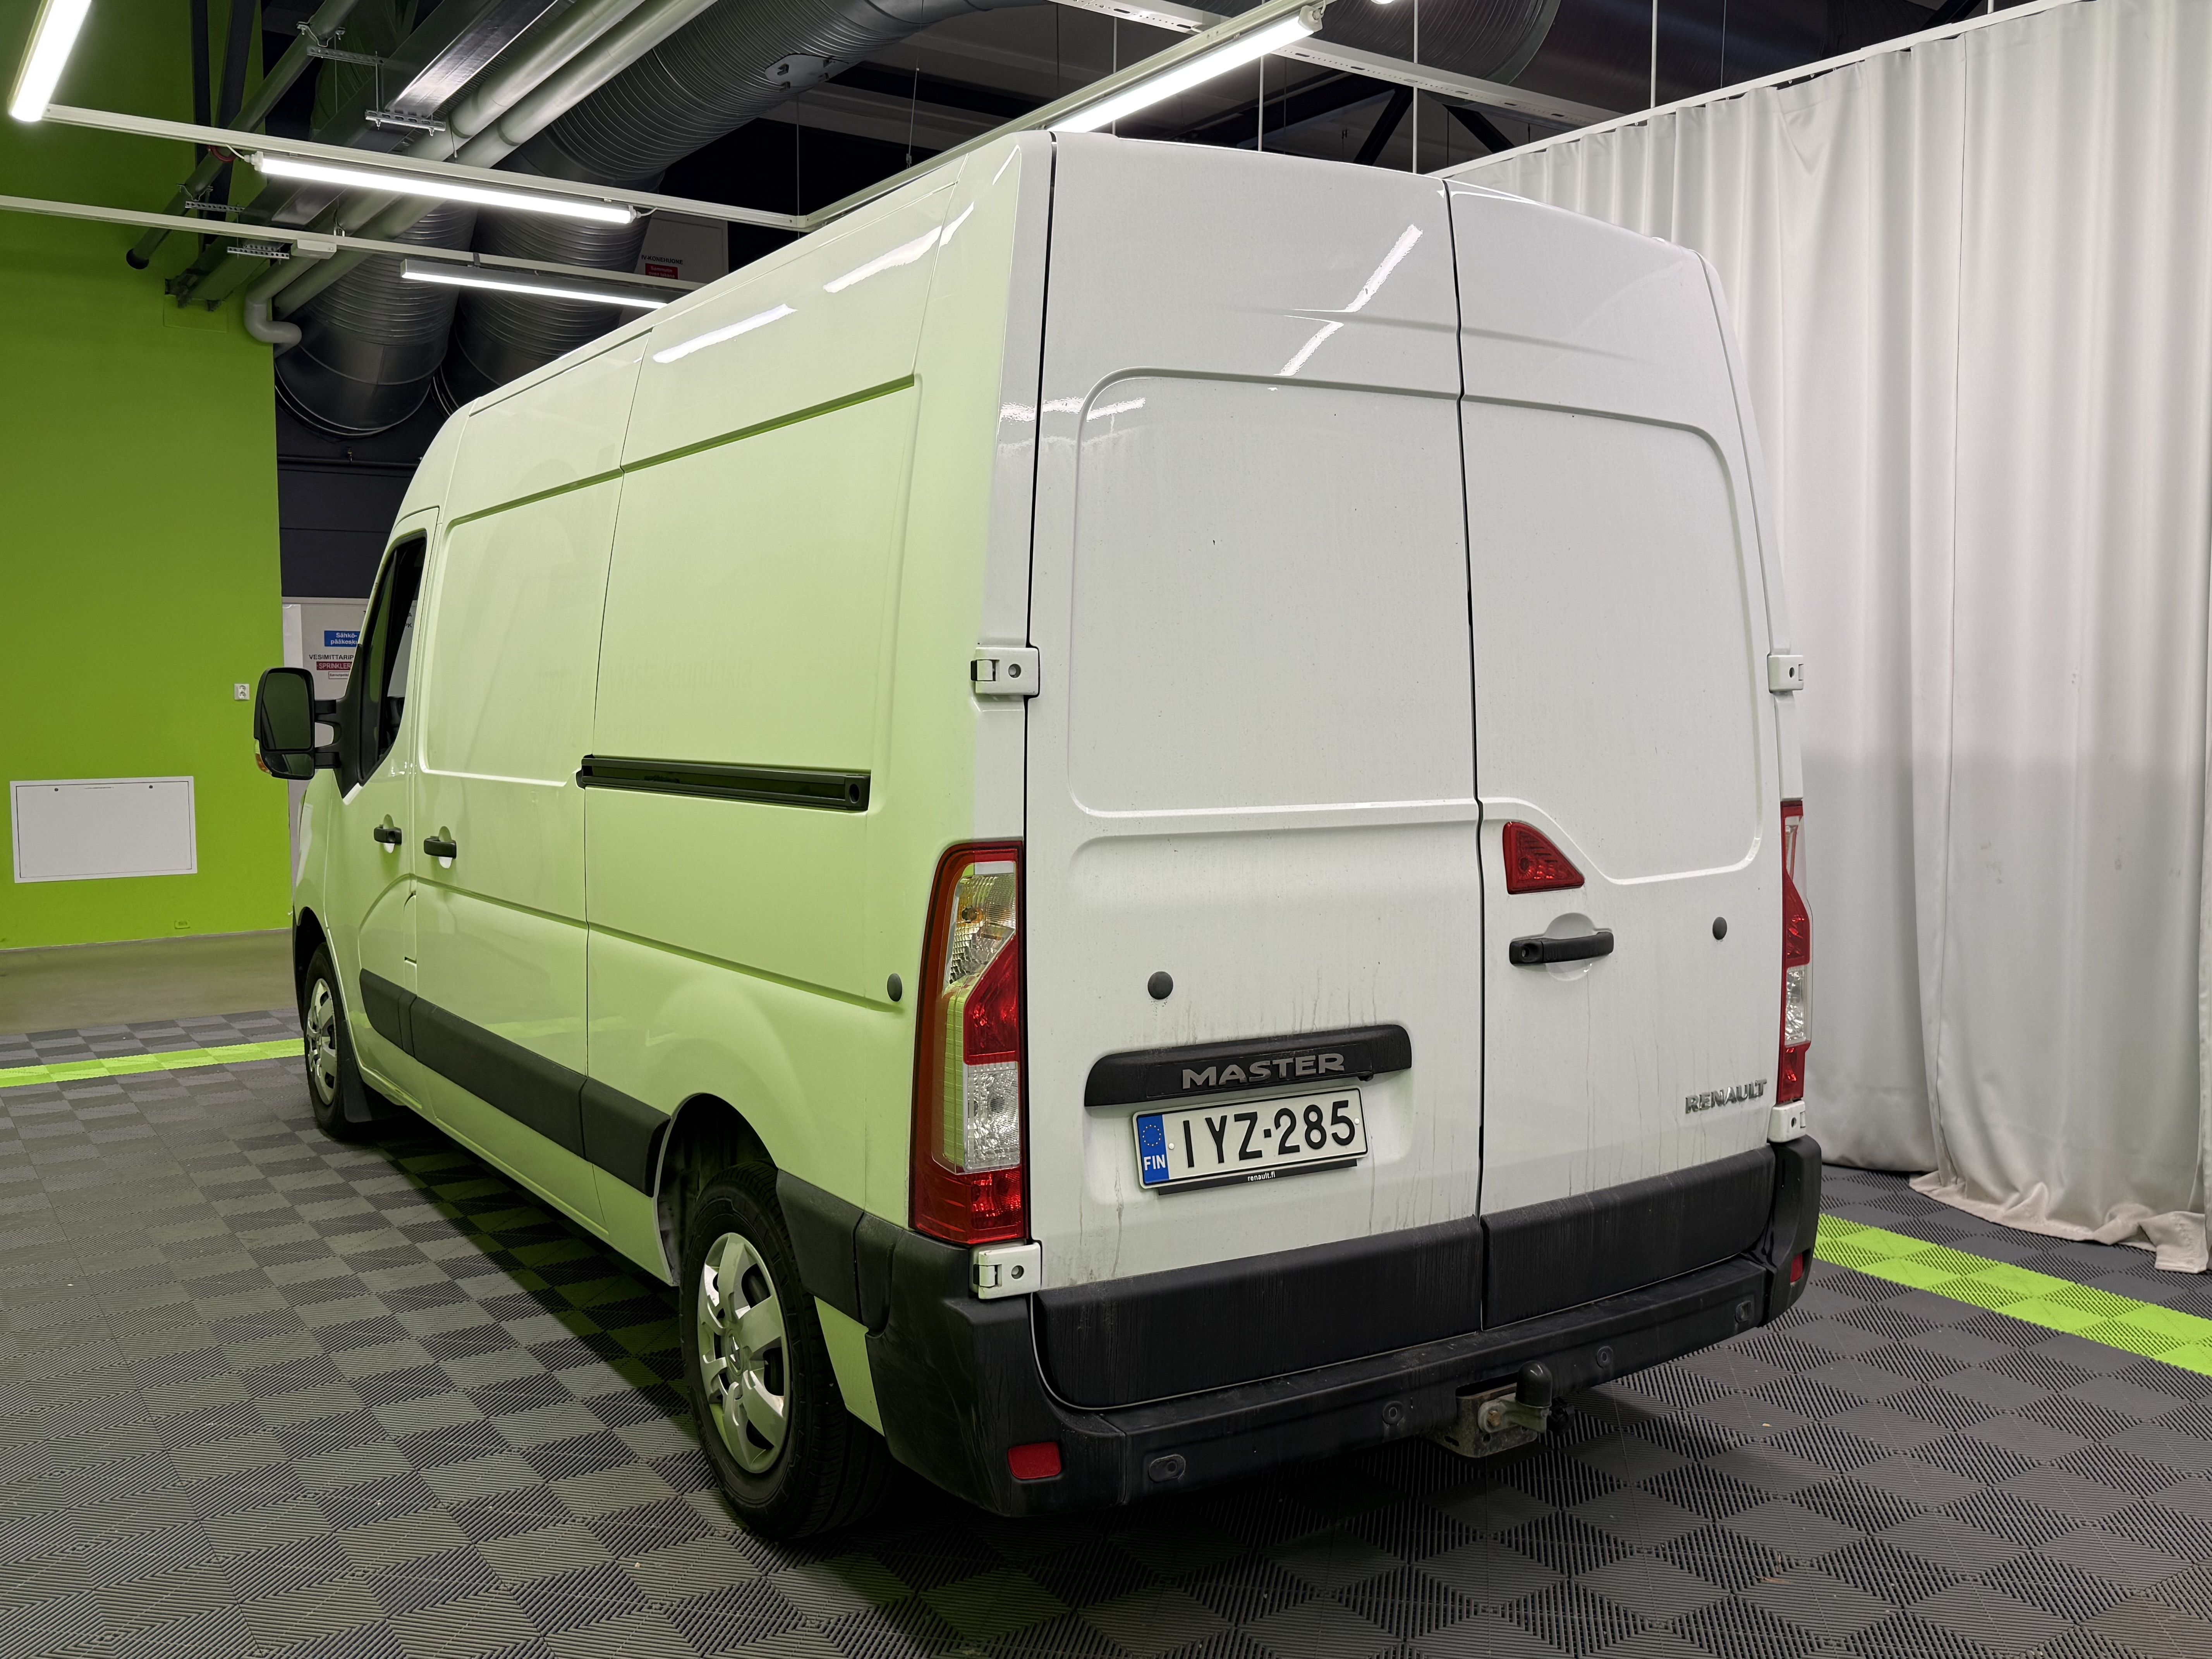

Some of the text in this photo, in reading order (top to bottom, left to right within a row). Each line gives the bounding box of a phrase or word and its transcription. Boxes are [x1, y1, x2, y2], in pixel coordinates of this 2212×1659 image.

[641, 255, 683, 264] IV-KONEHUONE
[1182, 1053, 1345, 1089] MASTER
[1685, 1079, 1767, 1114] RENAULT
[1183, 1100, 1355, 1168] IYZ-285
[1144, 1154, 1166, 1171] FIN
[1247, 1171, 1276, 1182] renault.fi
